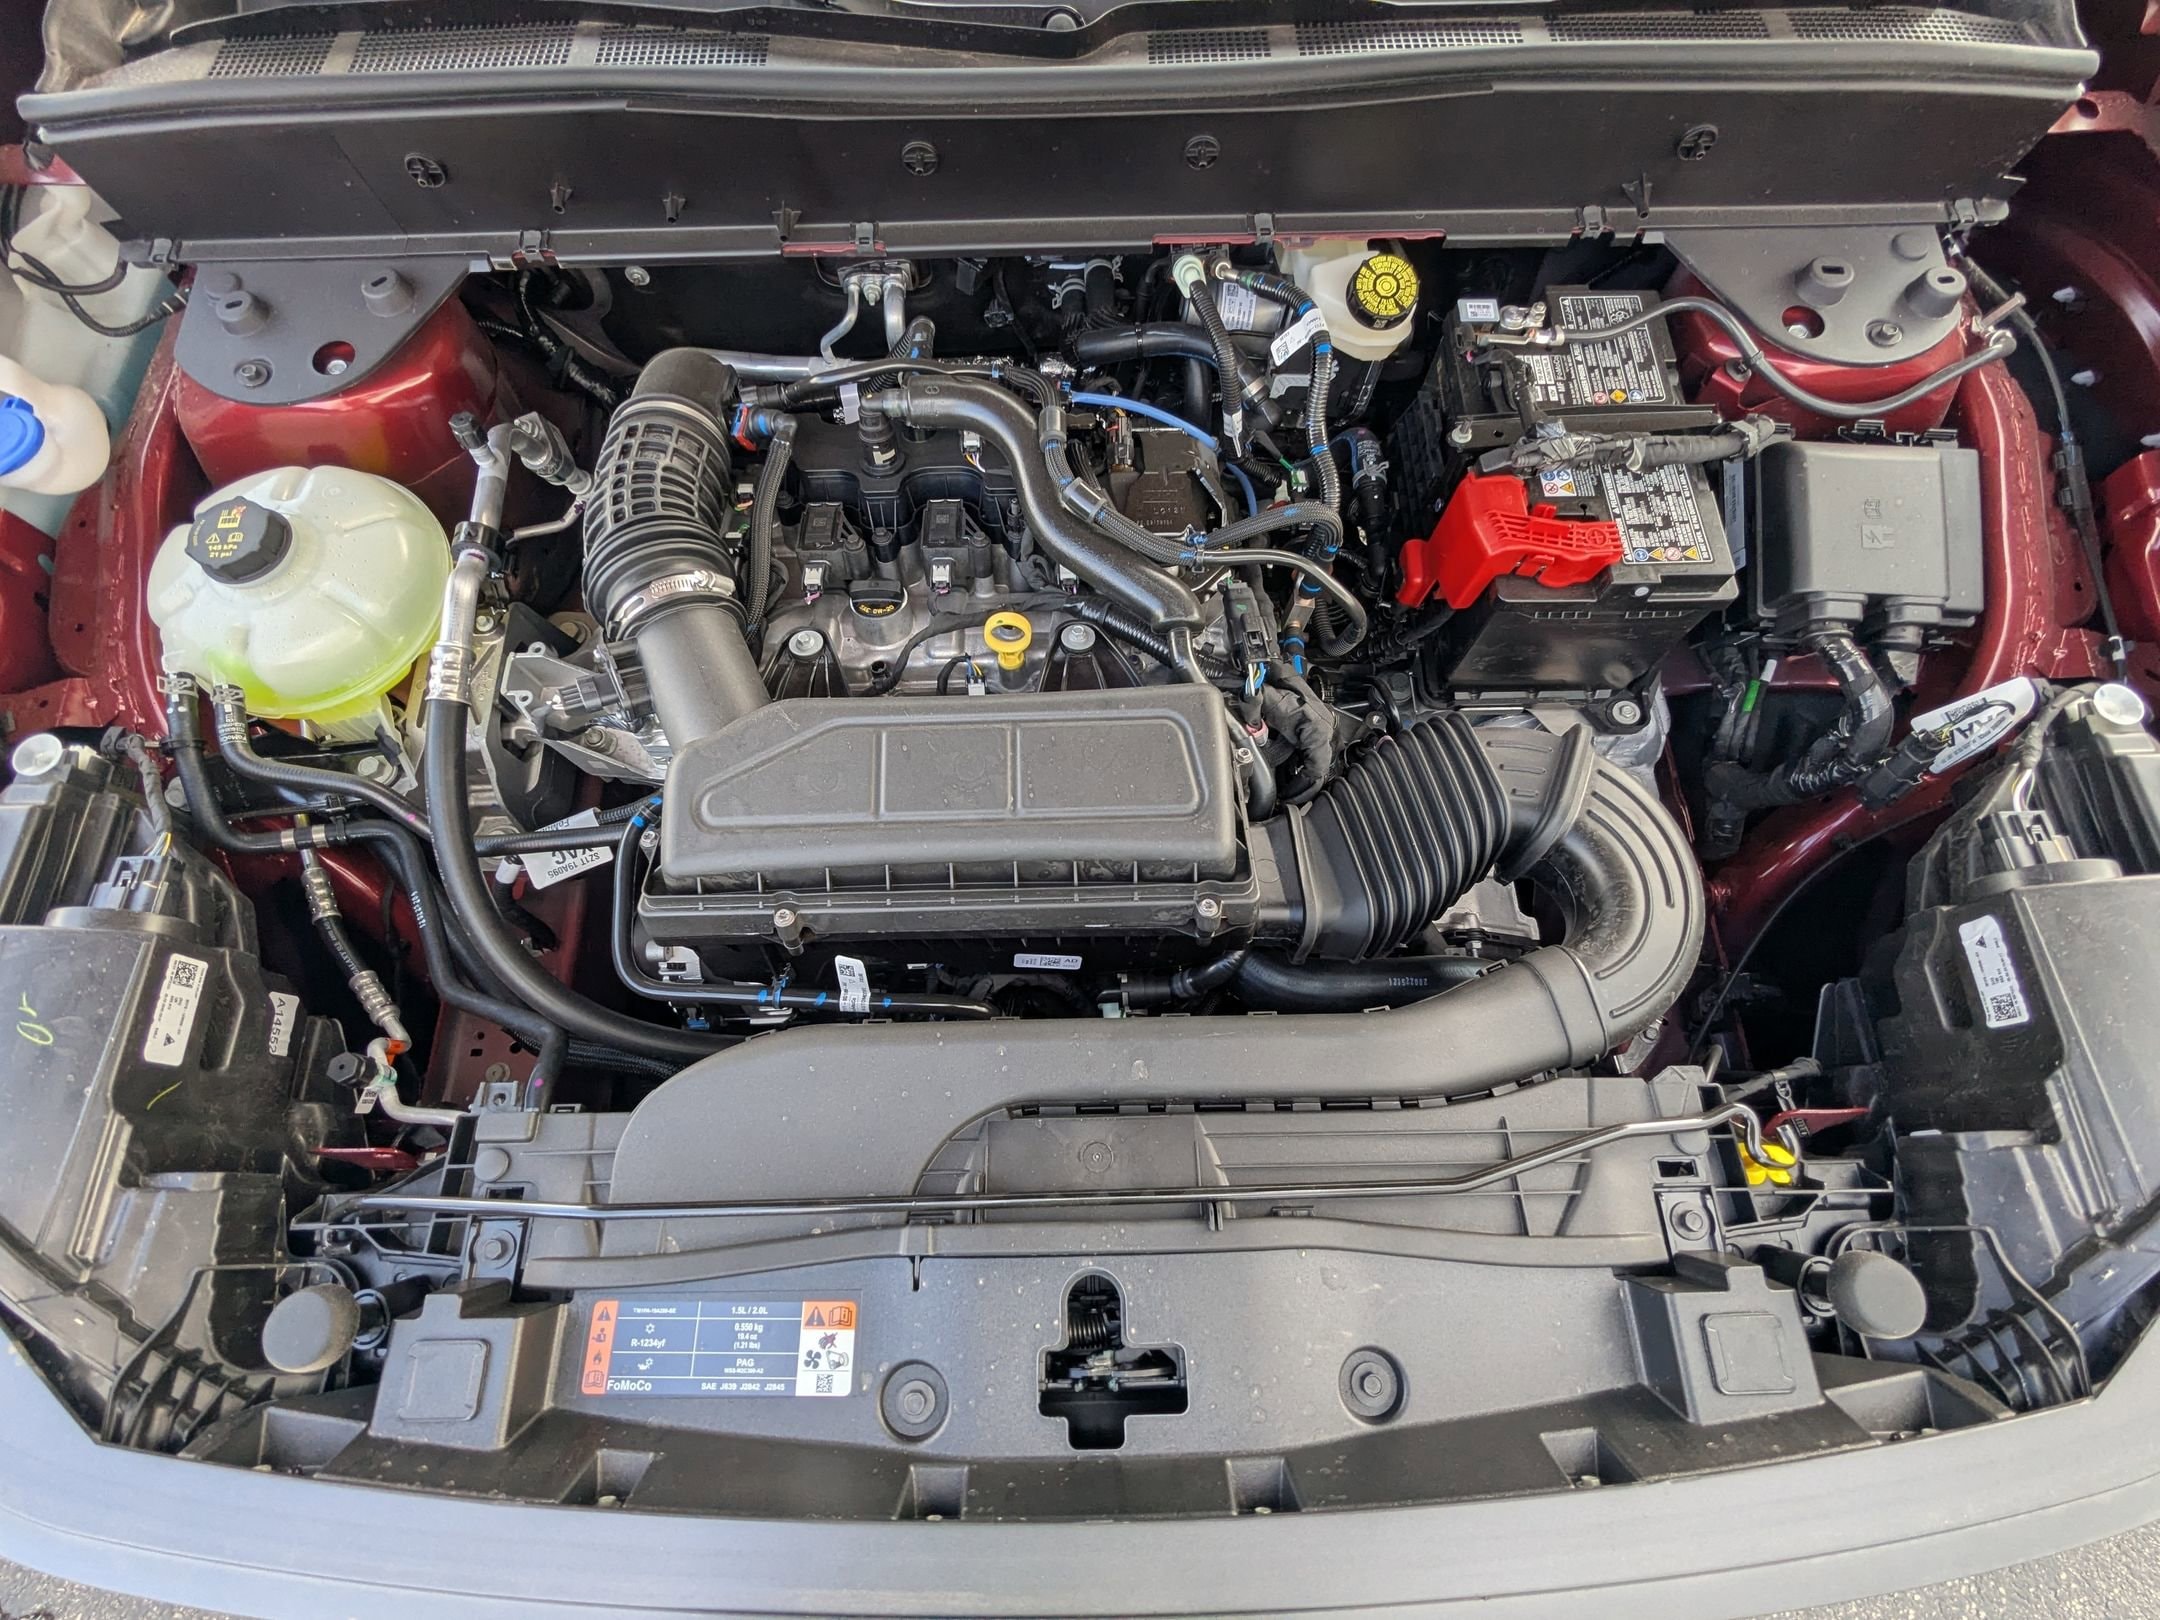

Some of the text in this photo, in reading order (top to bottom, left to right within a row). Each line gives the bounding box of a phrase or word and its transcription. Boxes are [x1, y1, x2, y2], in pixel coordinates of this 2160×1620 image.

[547, 852, 601, 879] SZ1T 19A095
[270, 996, 286, 1053] A14552
[731, 1306, 746, 1315] 1.5L
[752, 1306, 768, 1315] 2.0L
[734, 1323, 764, 1334] 0.550 kg
[630, 1338, 666, 1349] R-1234yf
[736, 1359, 755, 1367] PAG
[607, 1380, 652, 1391] FoMoCo
[701, 1382, 717, 1390] SAE
